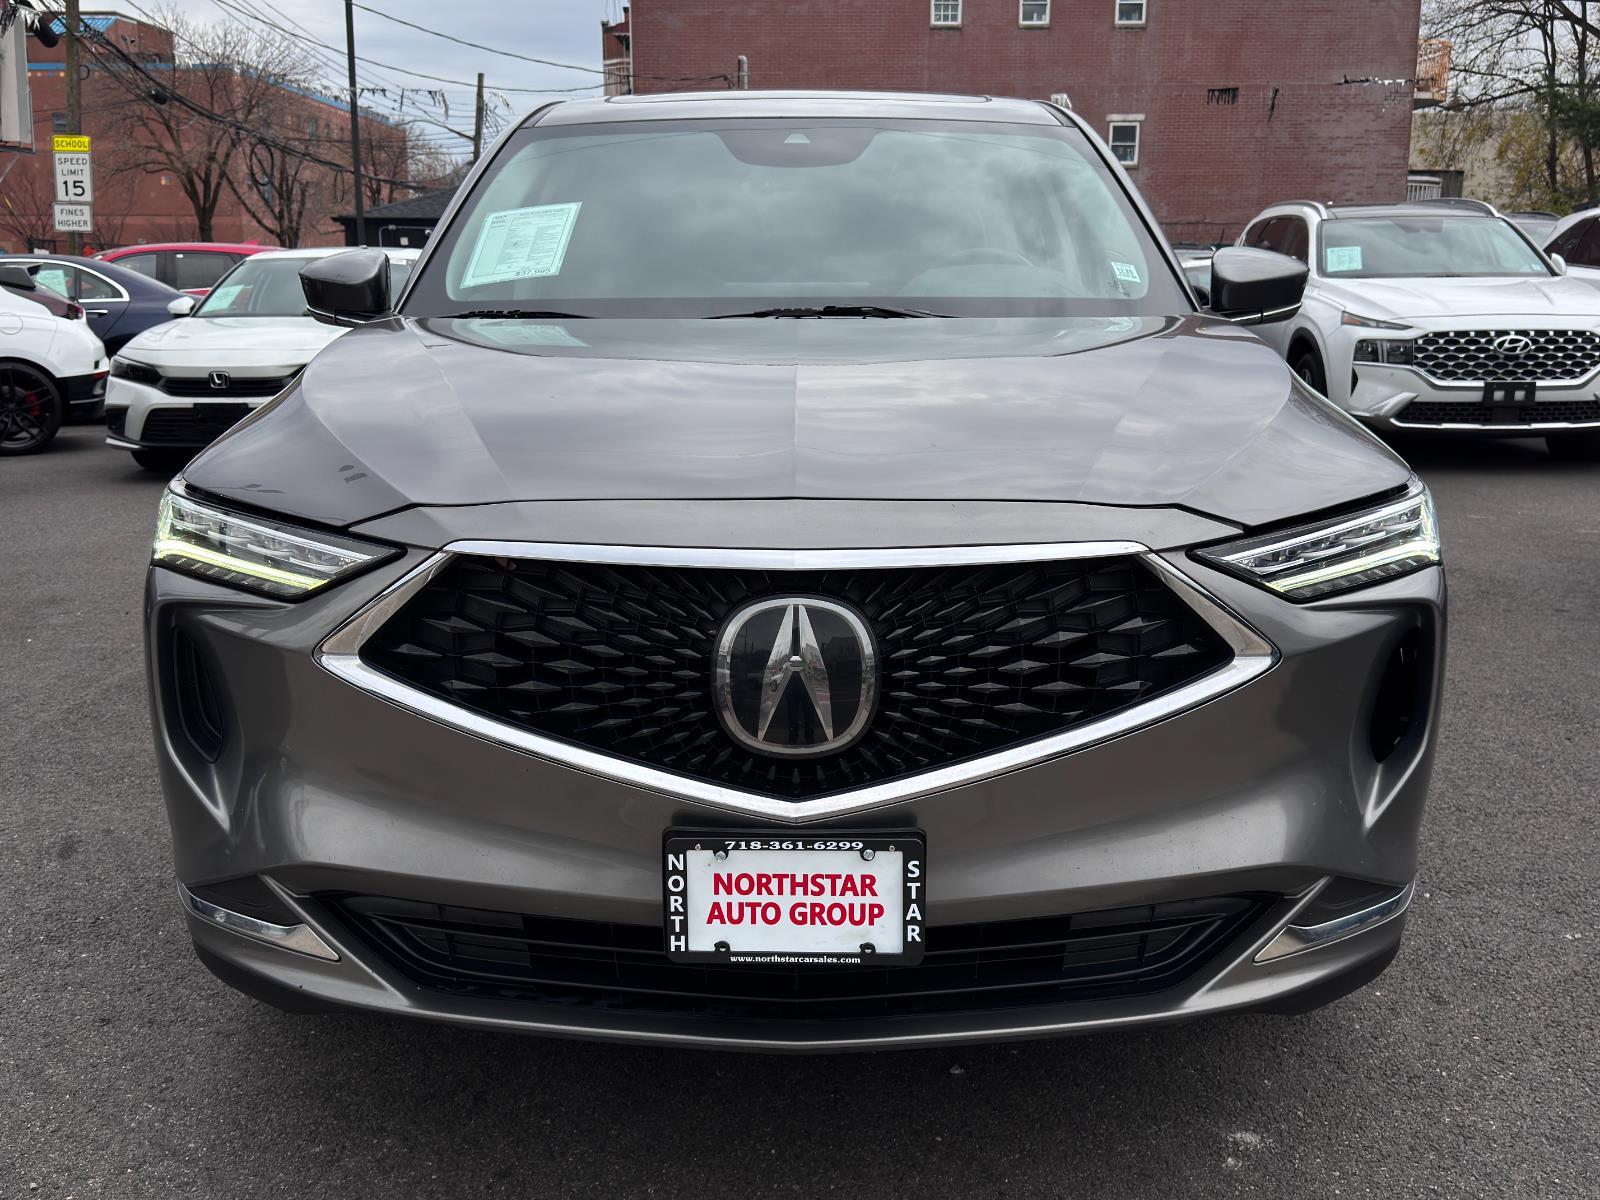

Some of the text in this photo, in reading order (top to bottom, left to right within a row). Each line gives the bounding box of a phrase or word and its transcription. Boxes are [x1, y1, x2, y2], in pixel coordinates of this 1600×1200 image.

[55, 140, 87, 148] SCHOOL
[57, 157, 88, 165] SPEED
[61, 168, 84, 176] LIMIT
[62, 180, 85, 197] 15
[60, 208, 84, 216] FINES
[57, 219, 88, 227] HIGHER
[724, 841, 864, 850] 718-361-6299
[713, 873, 878, 897] NORTHSTAR
[667, 853, 686, 952] NORTH
[906, 860, 922, 942] STAR
[706, 902, 885, 926] AUTO GROUP
[730, 955, 861, 964] www.northstarcarsales.com
